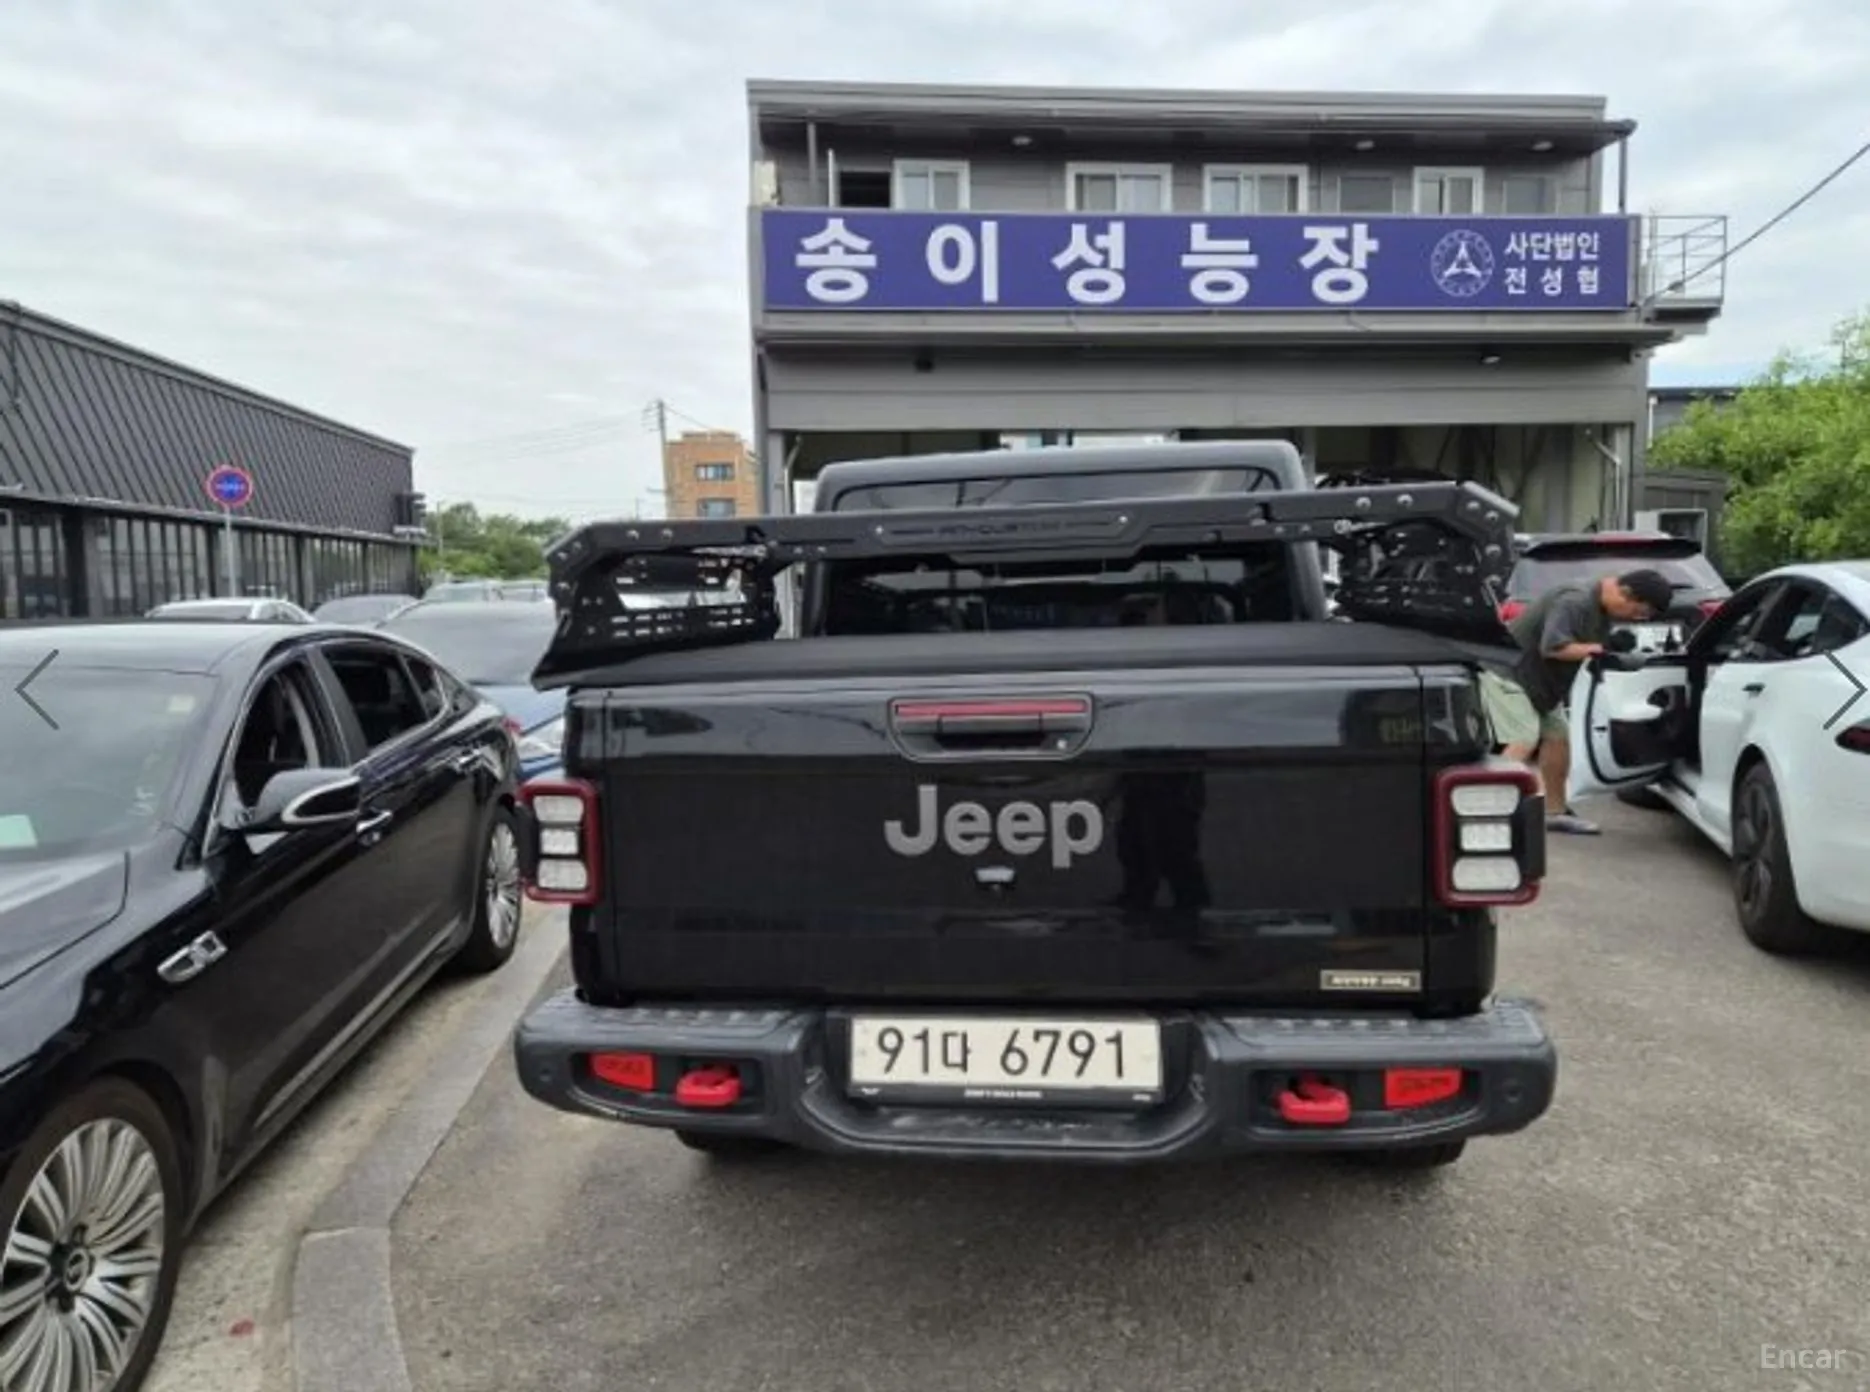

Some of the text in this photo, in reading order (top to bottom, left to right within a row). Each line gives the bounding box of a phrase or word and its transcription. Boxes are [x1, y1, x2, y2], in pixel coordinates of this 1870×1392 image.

[1504, 231, 1599, 261] 사단법인
[884, 784, 1104, 868] Jeep
[1000, 1028, 1124, 1079] 6791
